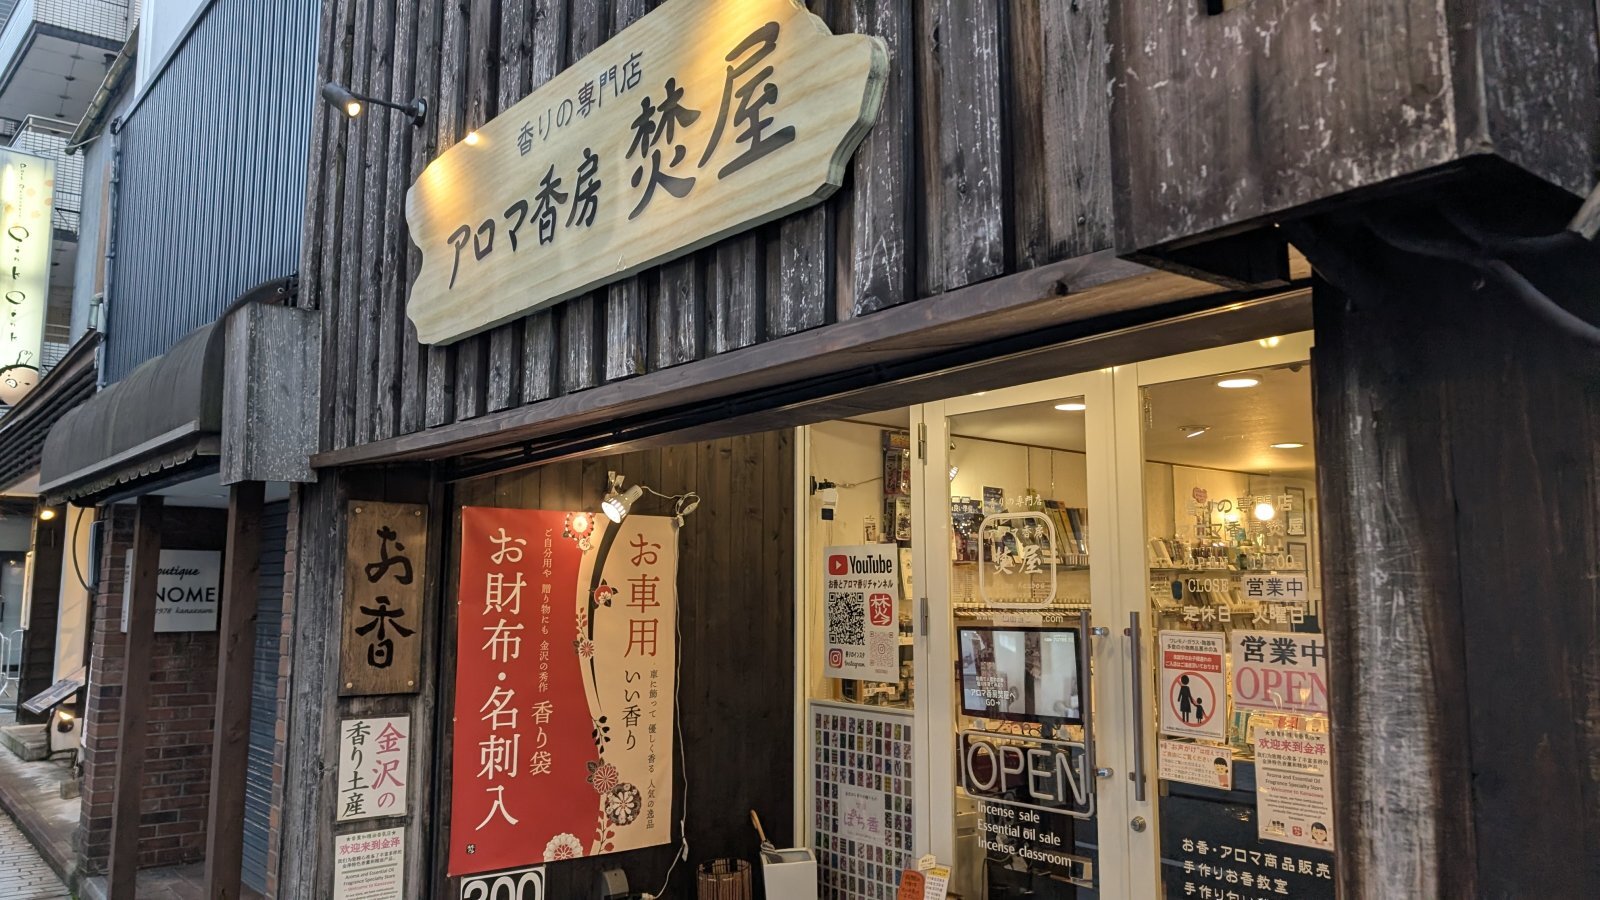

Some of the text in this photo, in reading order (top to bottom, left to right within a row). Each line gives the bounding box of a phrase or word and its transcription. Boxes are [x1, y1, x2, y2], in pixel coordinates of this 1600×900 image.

[517, 51, 645, 157] 香りの専門店
[447, 21, 797, 290] アロマ香房 焚屋
[157, 565, 201, 580] outique
[849, 554, 893, 574] YouTube
[156, 587, 216, 602] NOME
[355, 526, 416, 668] お香
[624, 533, 662, 658] お車用
[1188, 578, 1230, 593] CLOSE
[1246, 577, 1304, 597] 営業中
[537, 528, 553, 693] ご自分用や 贈り物にも 金沢の秀作
[1184, 605, 1305, 624] 定休日 火曜日
[1240, 635, 1326, 667] 営業中
[475, 527, 527, 831] お財布・名刺入
[1236, 667, 1327, 706] OPEN
[622, 670, 643, 751] いい香り
[529, 700, 554, 775] 香り袋
[647, 723, 657, 773] 優しく香る
[1259, 738, 1326, 755] 欢迎来到金泽
[342, 721, 371, 817] 香り土産
[372, 722, 407, 809] 金沢の
[967, 741, 1087, 806] OPEN
[978, 800, 1040, 824] Incense sale
[339, 837, 400, 855] 欢迎来到金泽
[978, 818, 1061, 846] Essential oil sale
[978, 836, 1072, 867] Incense classroom
[1182, 838, 1332, 879] お香・アロマ商品販売
[1183, 860, 1289, 895] 手作りお香教室
